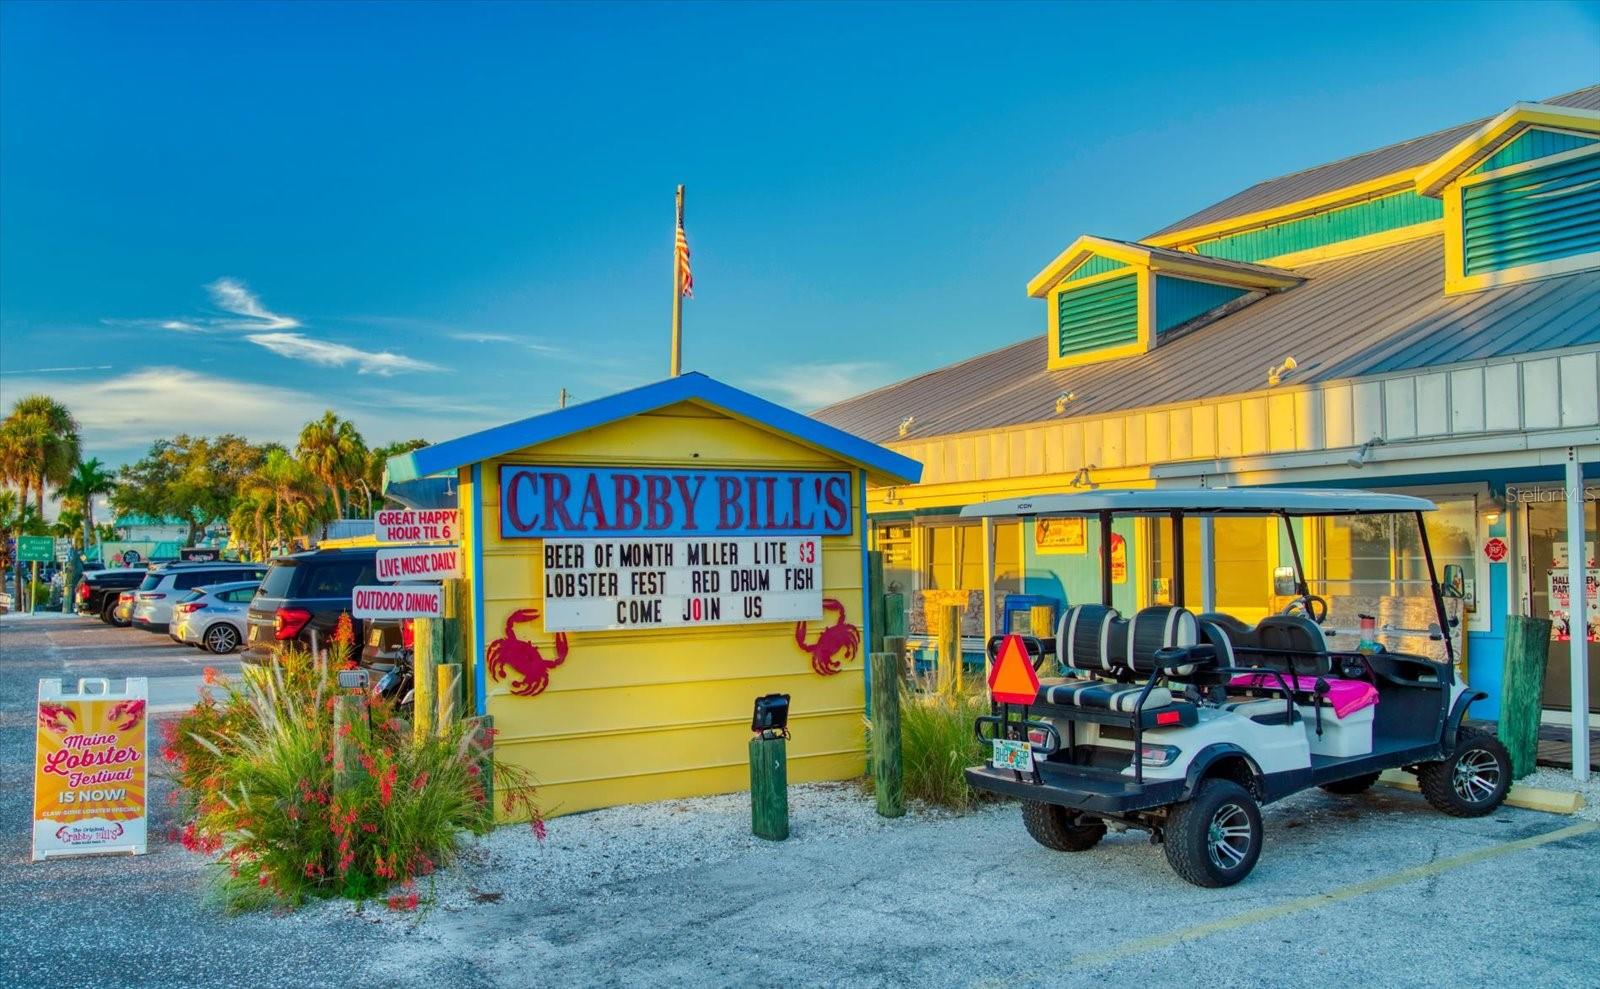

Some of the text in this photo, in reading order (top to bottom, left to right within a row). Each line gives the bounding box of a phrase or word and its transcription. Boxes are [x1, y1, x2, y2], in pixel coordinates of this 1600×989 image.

[507, 471, 848, 532] CRABBY BILL'S
[379, 510, 457, 525] GREAT HAPPY
[387, 525, 451, 540] HOUR TIL 6
[380, 551, 456, 577] LIVE MUSIC DAILY
[545, 544, 584, 568] BEER
[594, 544, 613, 567] OF
[620, 543, 673, 567] MONTH
[754, 542, 787, 565] LITE
[800, 541, 815, 564] $3
[546, 568, 813, 597] LOBSTER FEST RED DRUM FISH
[356, 590, 438, 613] OUTDOOR DINING
[617, 597, 762, 624] COME JOIN US
[63, 733, 117, 750] Maine
[43, 746, 140, 775] Lobster
[69, 768, 133, 787] Festival
[59, 789, 126, 804] IS NOW!
